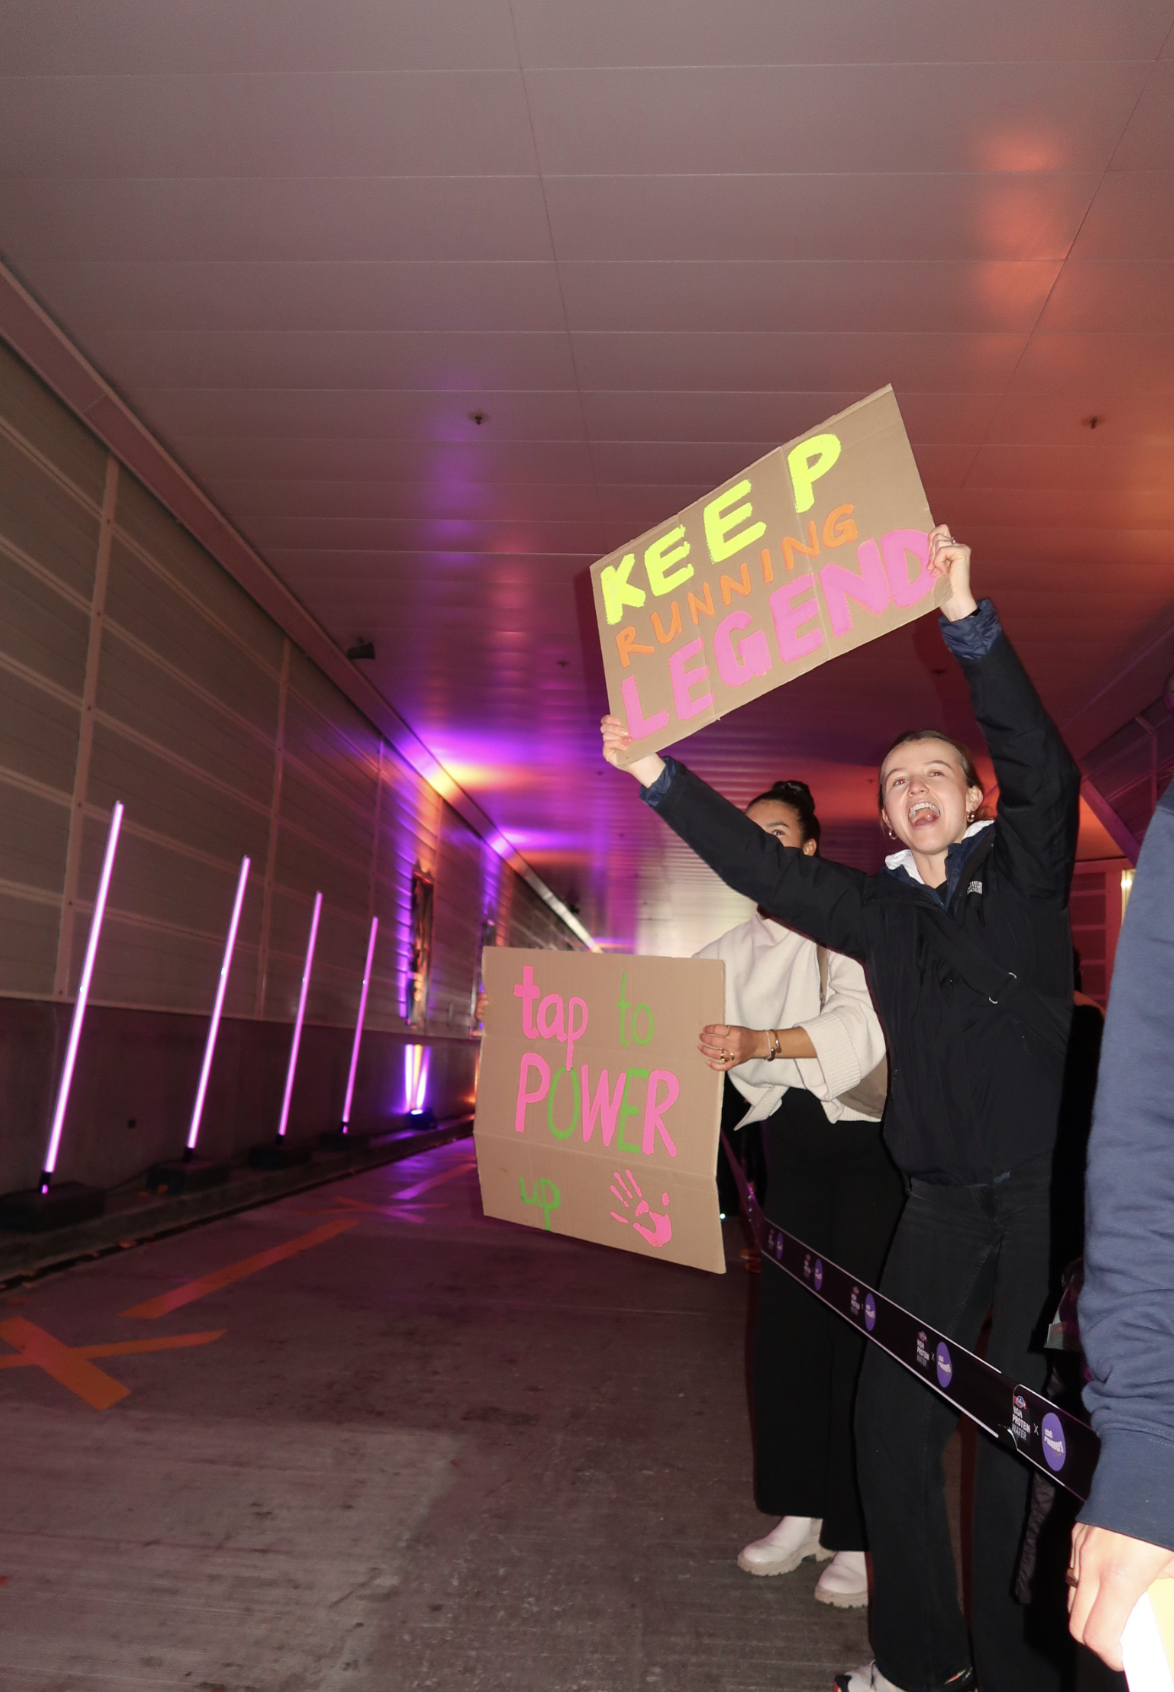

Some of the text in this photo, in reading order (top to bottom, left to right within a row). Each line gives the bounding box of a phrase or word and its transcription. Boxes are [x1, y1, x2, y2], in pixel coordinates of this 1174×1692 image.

[600, 433, 841, 625] KEEP
[615, 504, 859, 668] RUNNING
[621, 528, 938, 741] LEGEND
[514, 965, 654, 1071] tap to
[515, 1053, 680, 1157] POWER
[519, 1175, 561, 1231] up
[1012, 1413, 1031, 1434] PROTEIN
